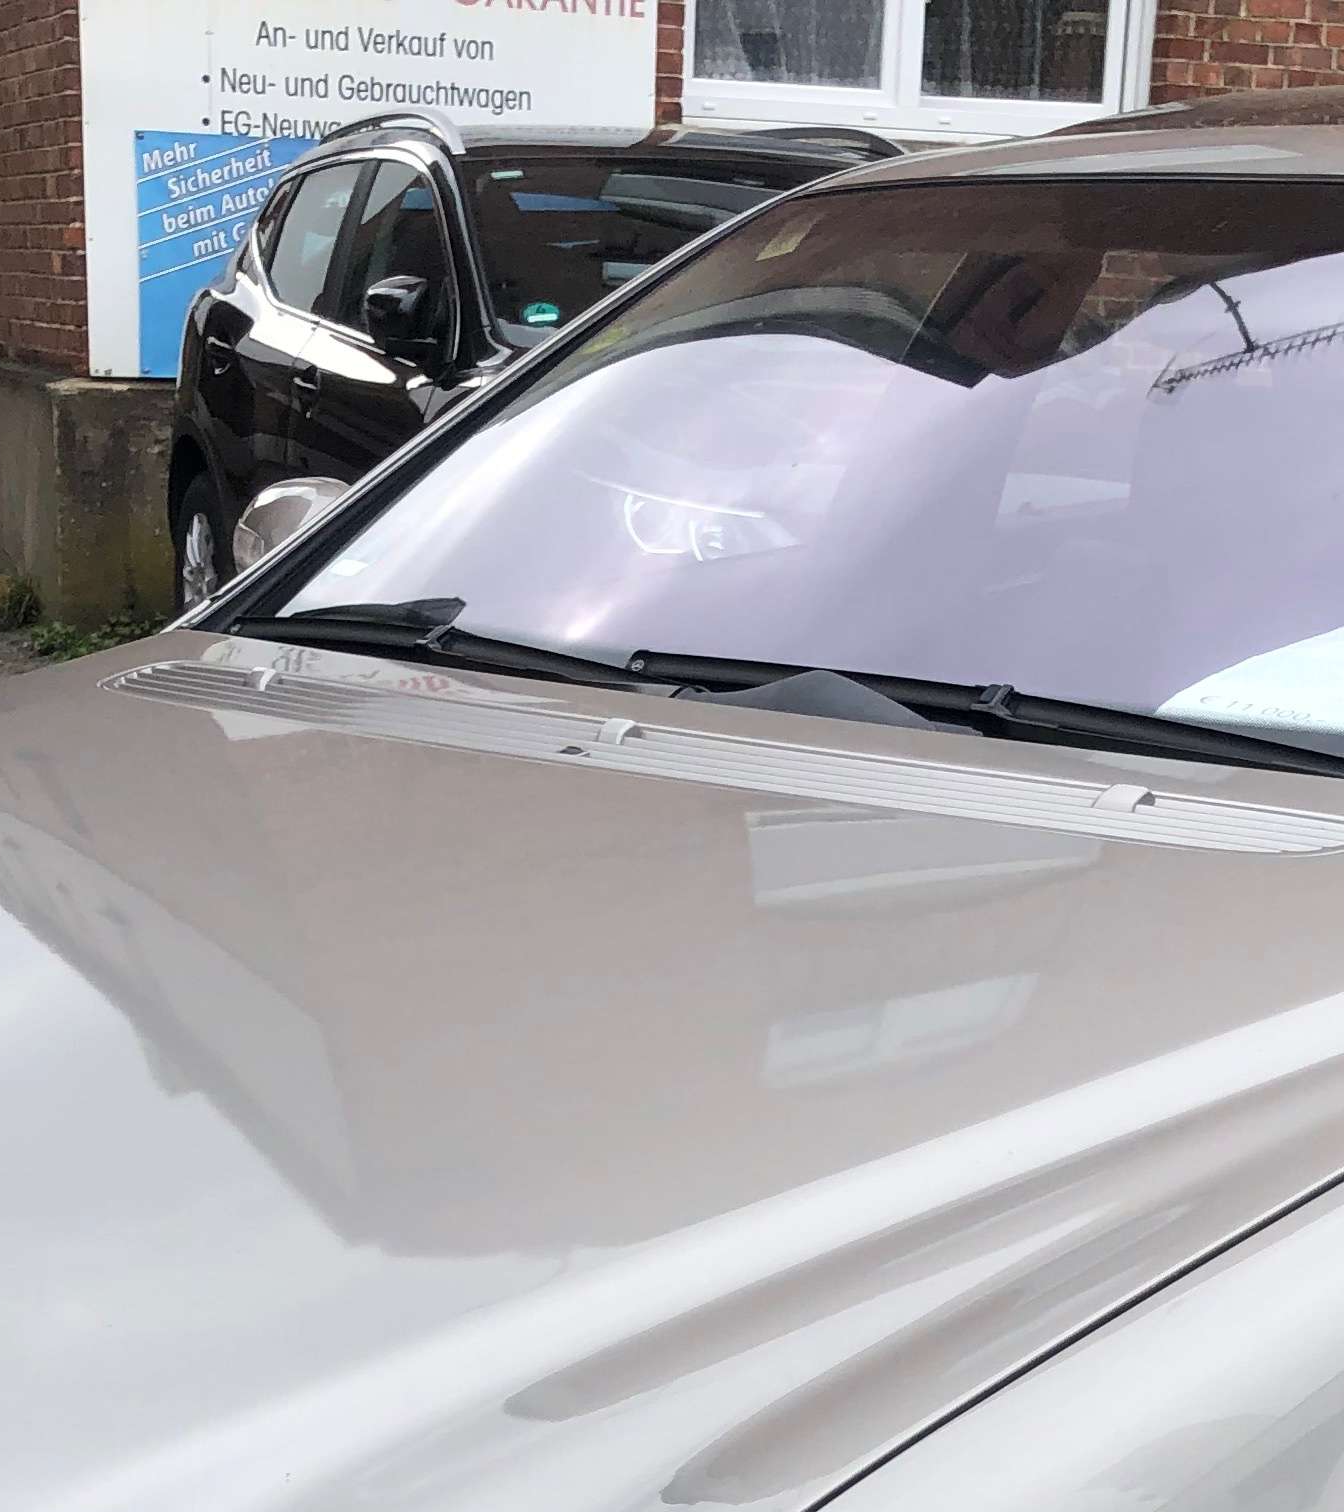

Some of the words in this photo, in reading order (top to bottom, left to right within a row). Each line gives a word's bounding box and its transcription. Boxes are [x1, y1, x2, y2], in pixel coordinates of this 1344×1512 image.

[255, 20, 296, 48] An-
[305, 26, 349, 52] und
[358, 27, 446, 59] Verkauf
[454, 37, 495, 61] von
[220, 67, 276, 96] Neu-
[285, 73, 329, 99] und
[338, 74, 533, 116] Gebrauchtwagen
[142, 141, 198, 173] Mehr
[167, 143, 273, 200] Sicherheit
[162, 201, 216, 233] beim
[220, 179, 275, 212] Auto
[192, 229, 229, 257] mit
